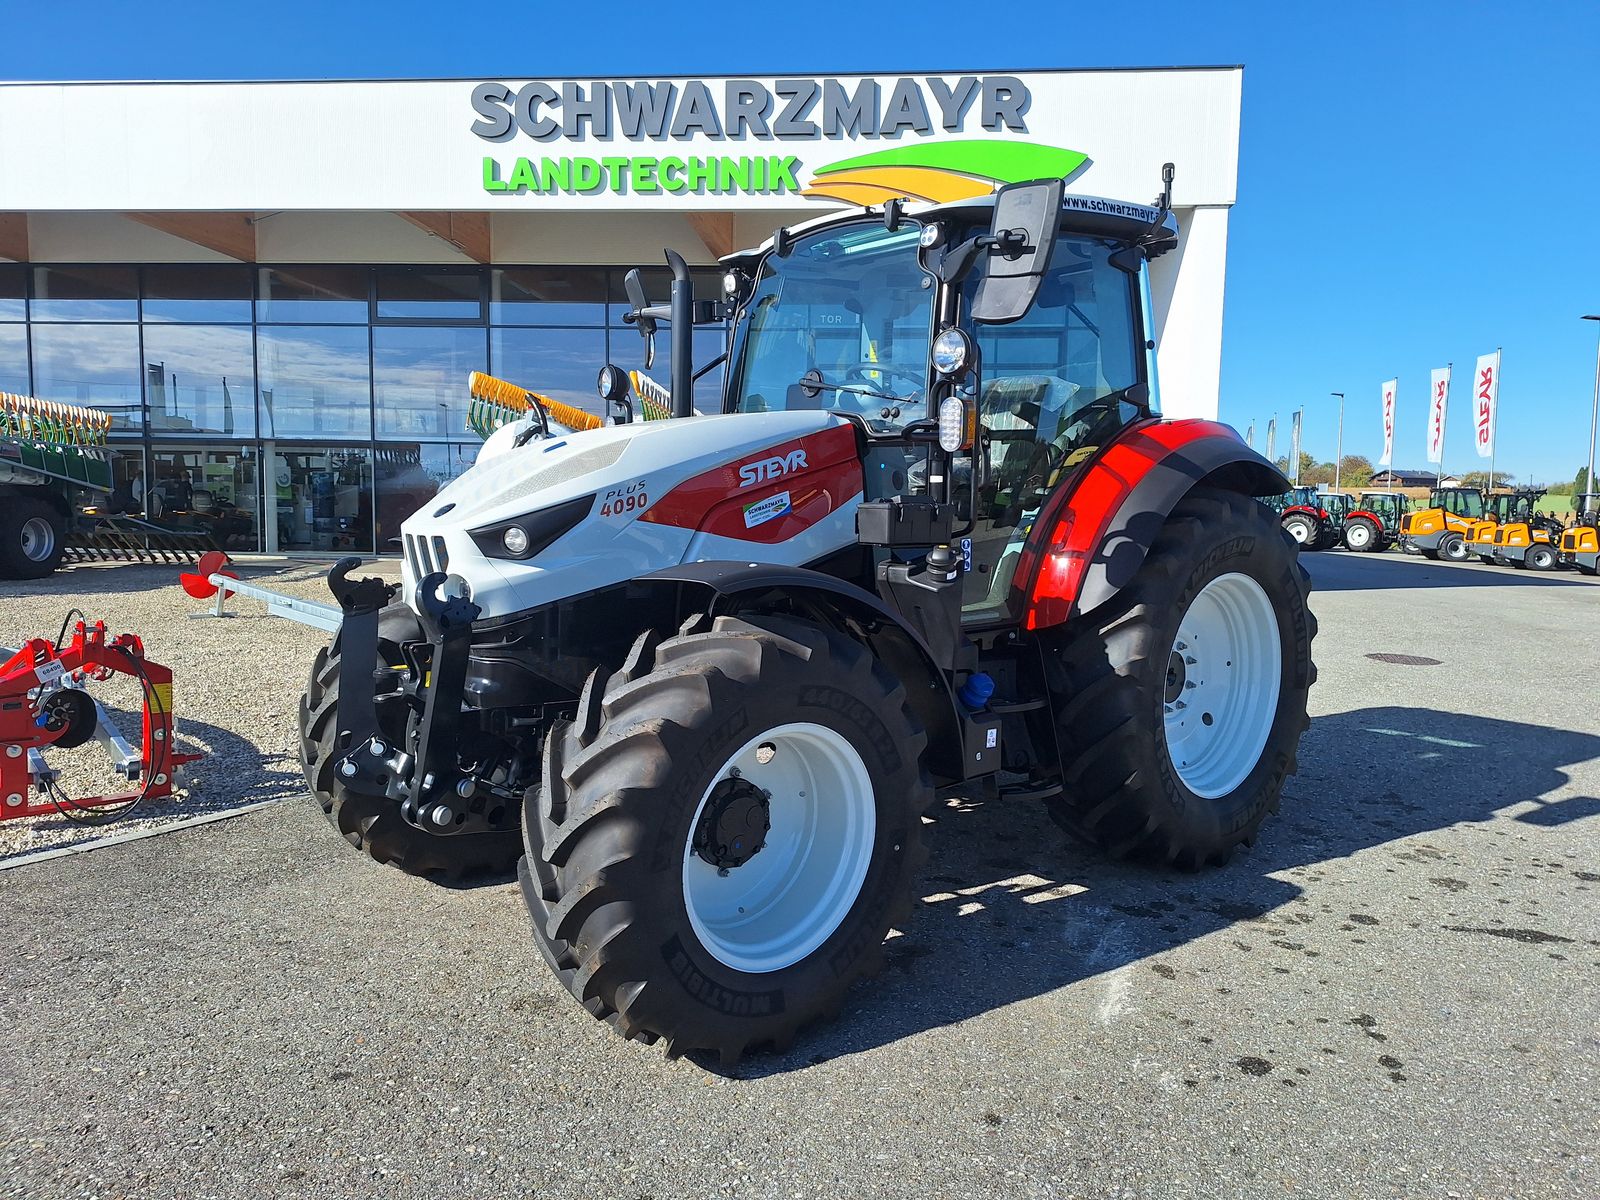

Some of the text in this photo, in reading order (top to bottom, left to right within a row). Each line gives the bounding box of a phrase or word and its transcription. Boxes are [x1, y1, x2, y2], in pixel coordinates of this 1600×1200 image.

[470, 76, 1030, 139] SCHWARZMAYR
[482, 154, 799, 193] LANDTECHNIK
[1063, 197, 1160, 222] www.schwarzmayr.a
[820, 315, 842, 324] TOR
[739, 449, 808, 487] STEYR
[605, 480, 646, 500] PLUS
[600, 492, 647, 517] 4090
[748, 498, 784, 515] SCHWARZMAYR
[670, 951, 771, 1014] MULTIBIB
